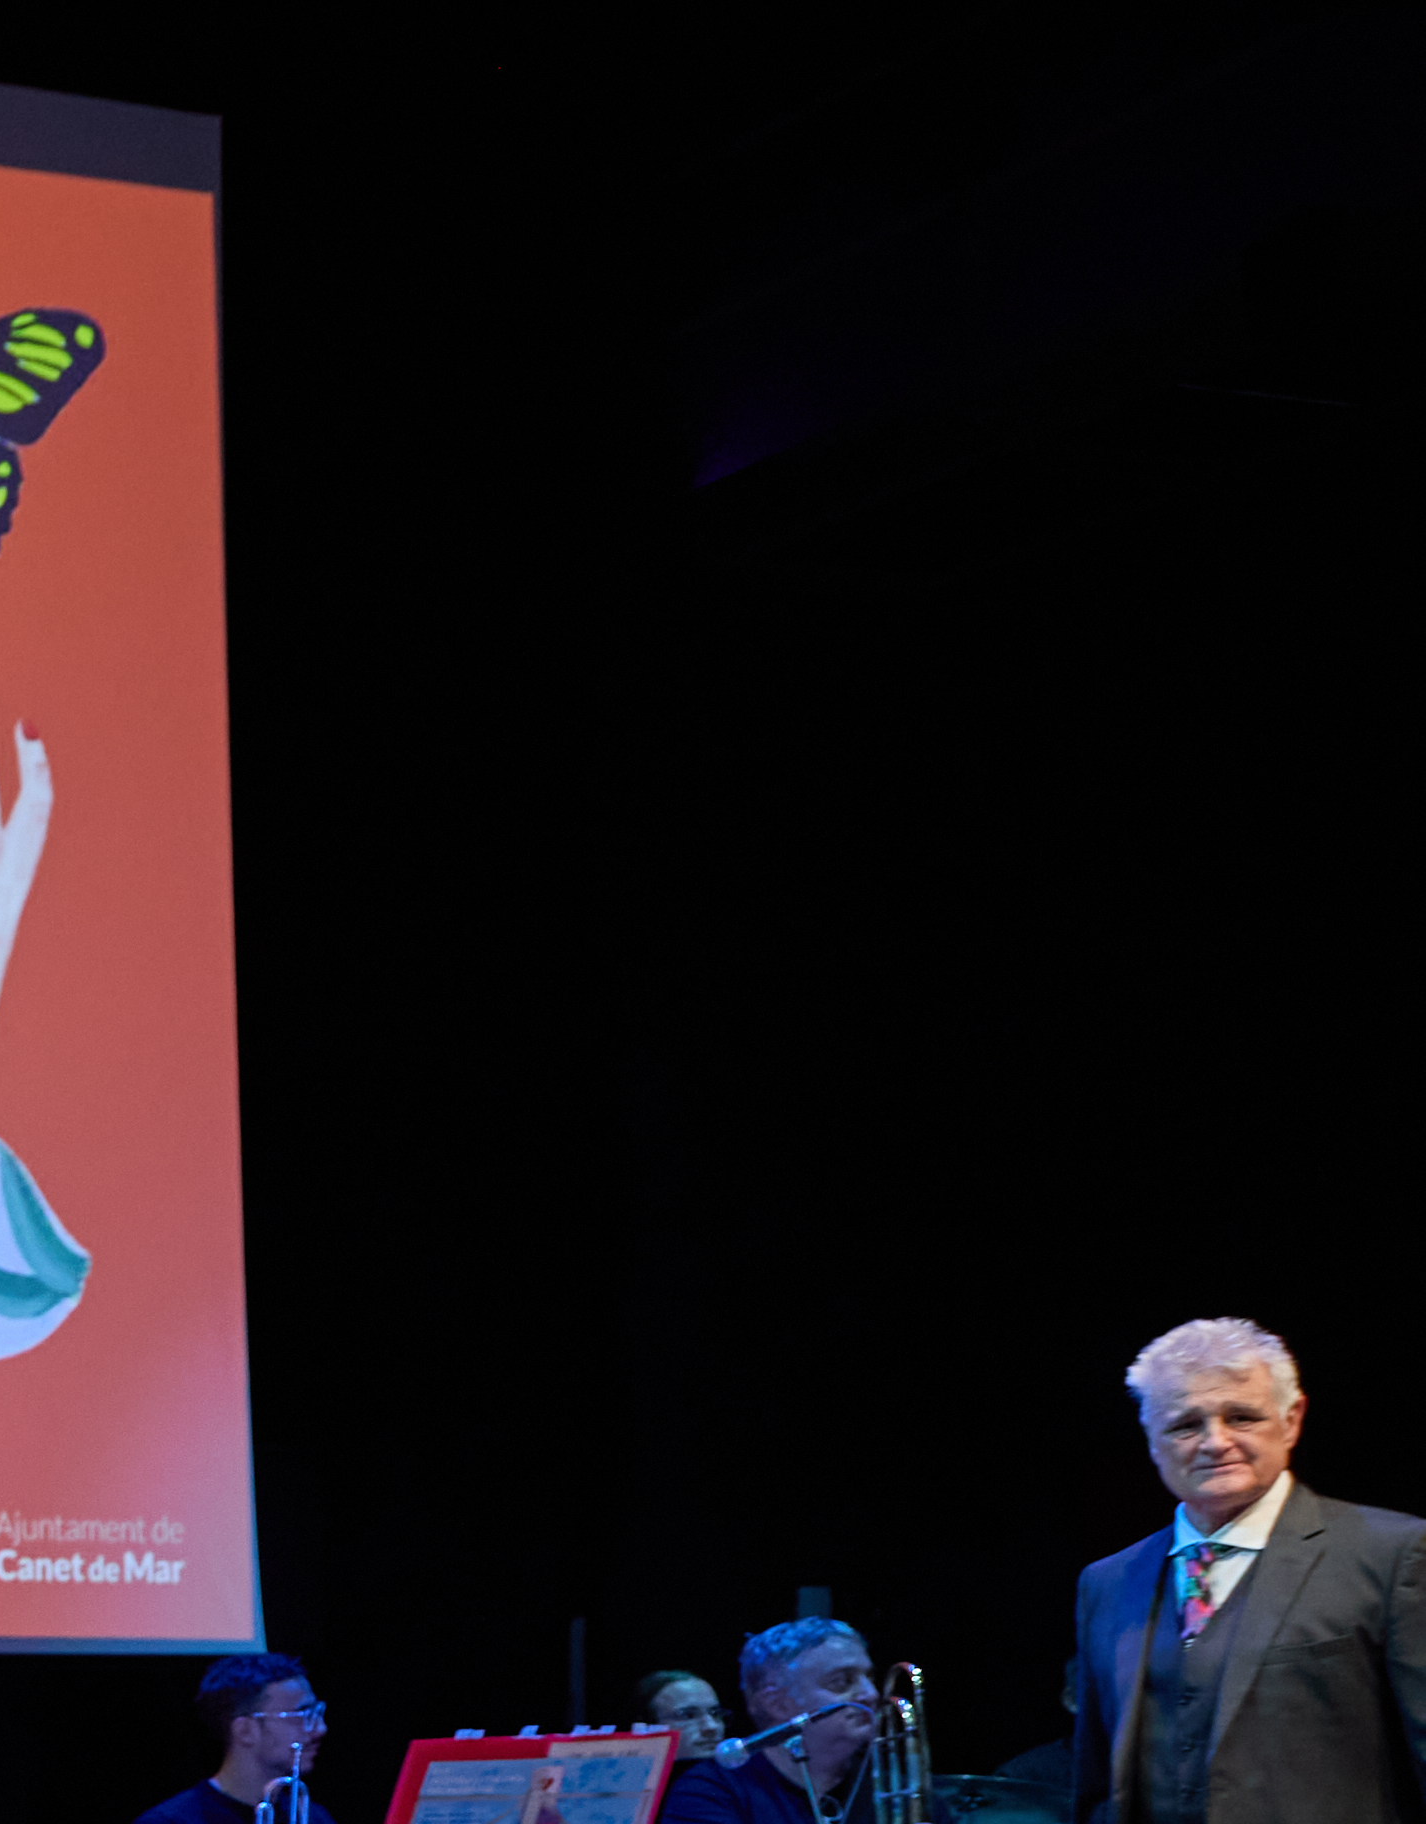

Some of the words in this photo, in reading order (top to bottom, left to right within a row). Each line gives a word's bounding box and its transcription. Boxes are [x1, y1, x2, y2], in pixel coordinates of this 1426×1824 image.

[151, 1516, 185, 1545] de
[86, 1555, 121, 1584] de
[123, 1551, 185, 1584] Mar
